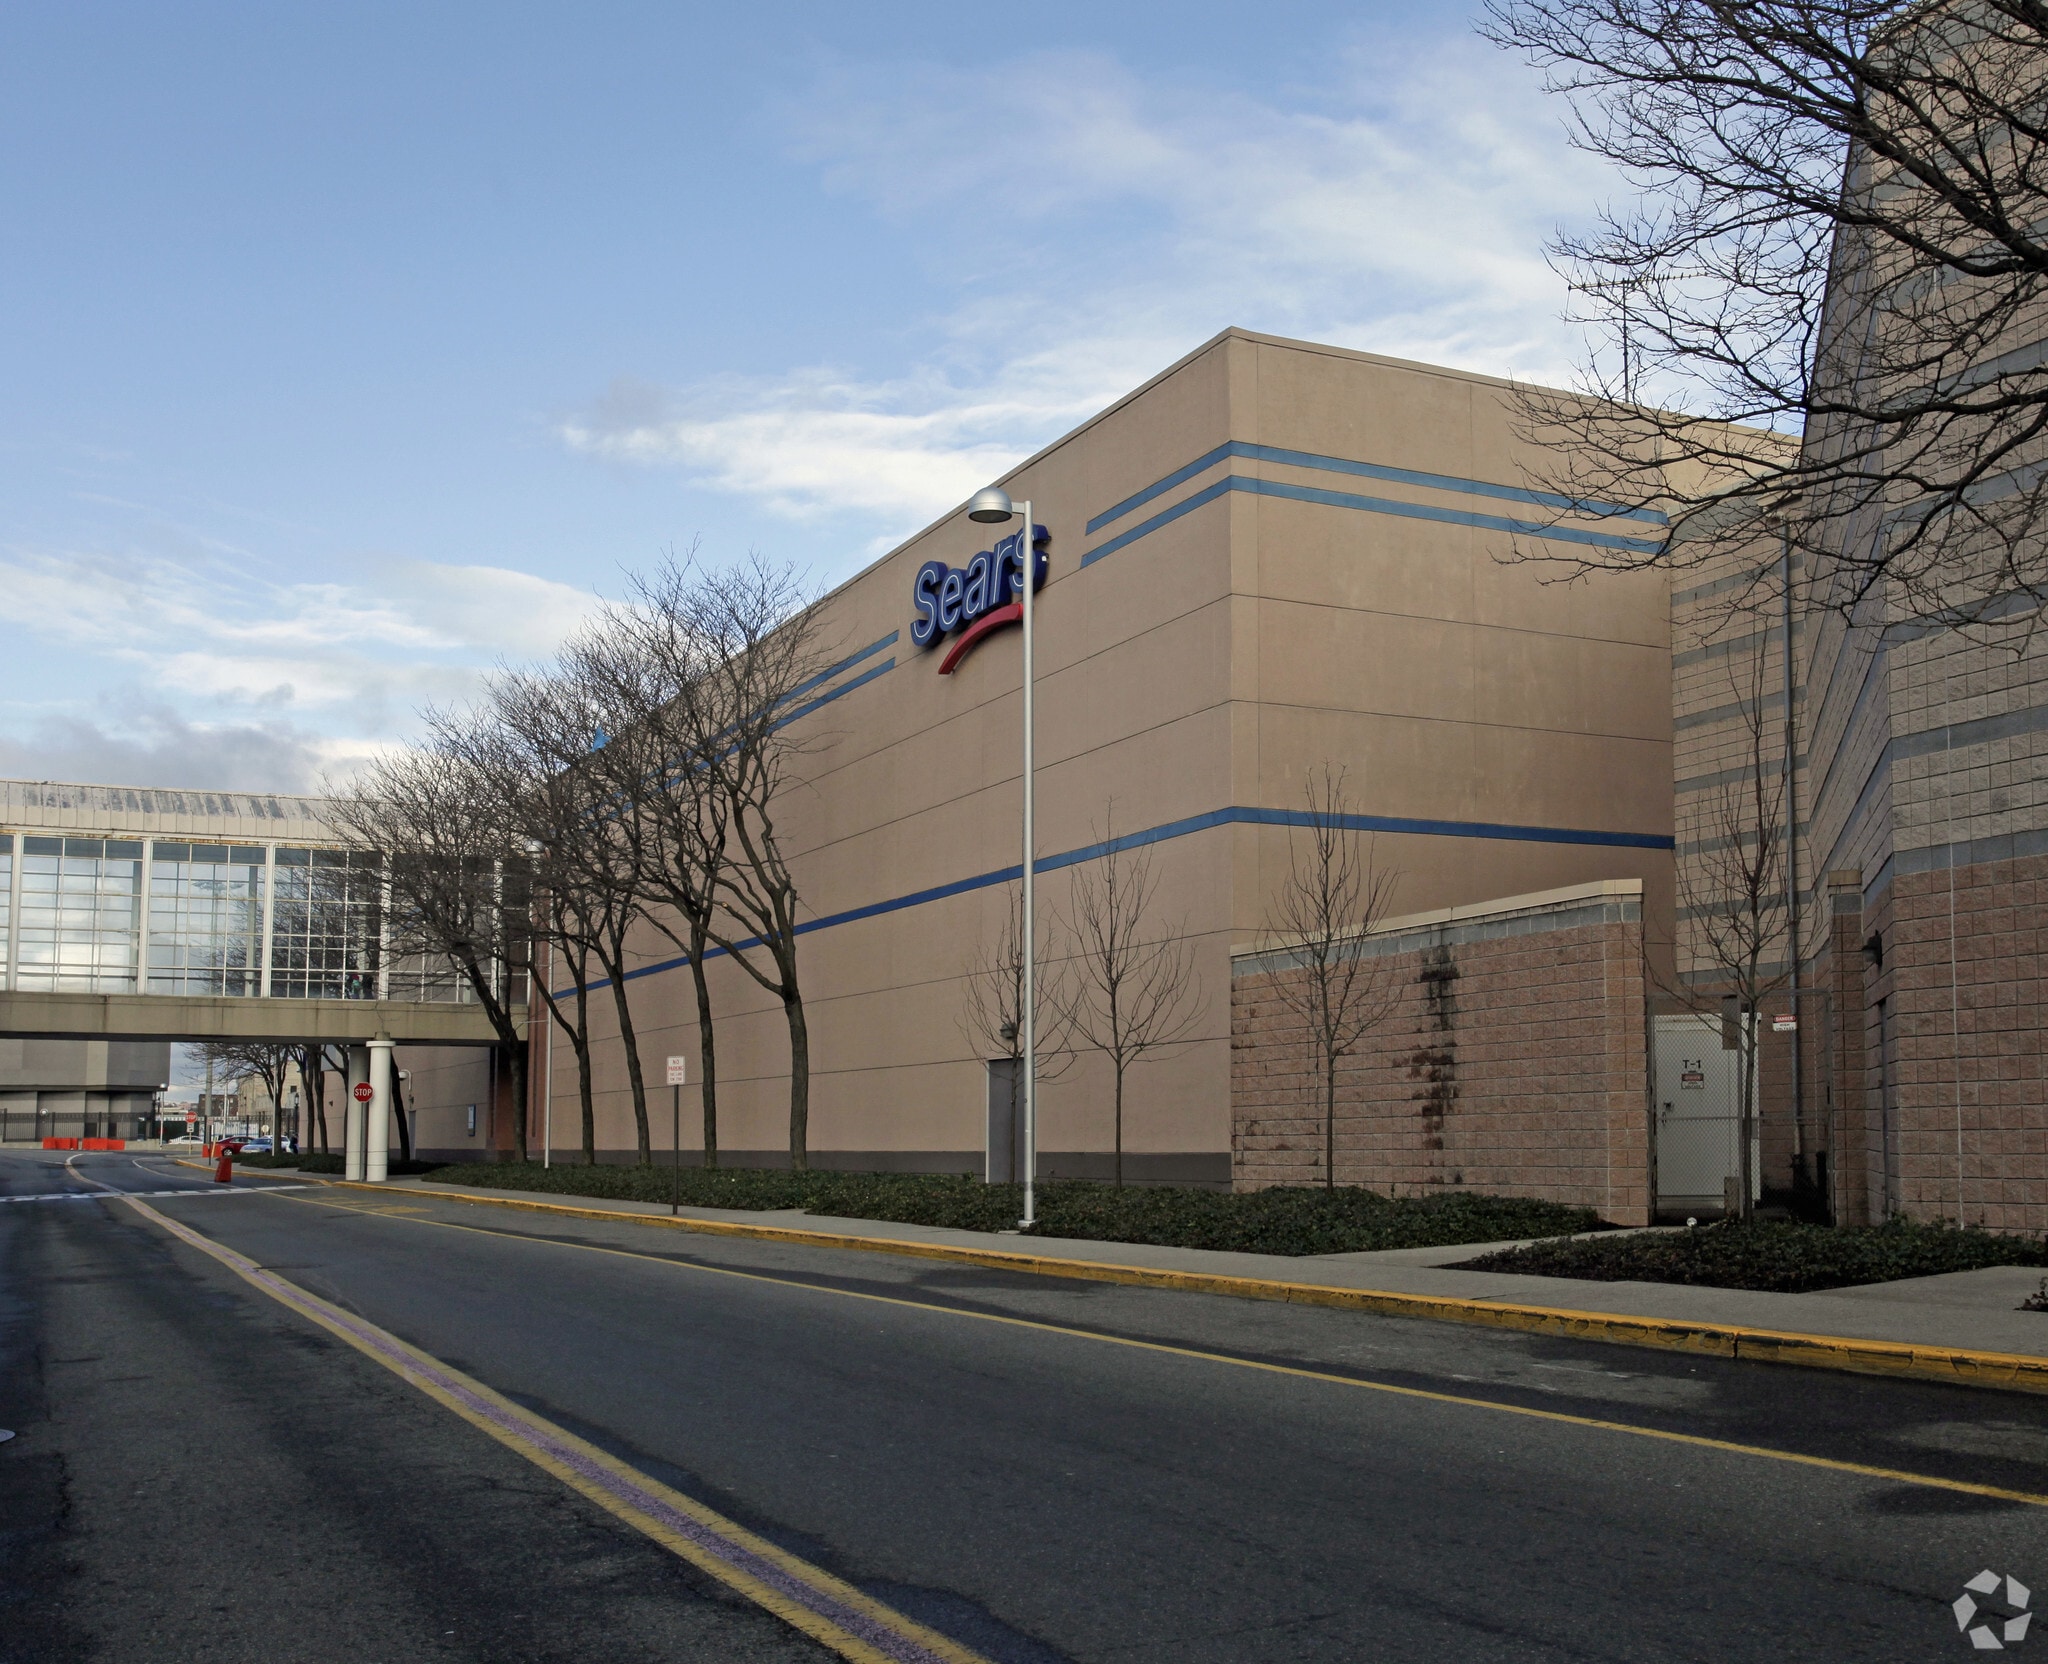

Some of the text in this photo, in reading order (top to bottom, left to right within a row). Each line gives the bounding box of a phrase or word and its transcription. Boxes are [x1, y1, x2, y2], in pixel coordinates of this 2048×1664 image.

[910, 524, 1050, 647] Sears
[1682, 1059, 1701, 1069] T-1
[354, 1088, 372, 1097] STOP
